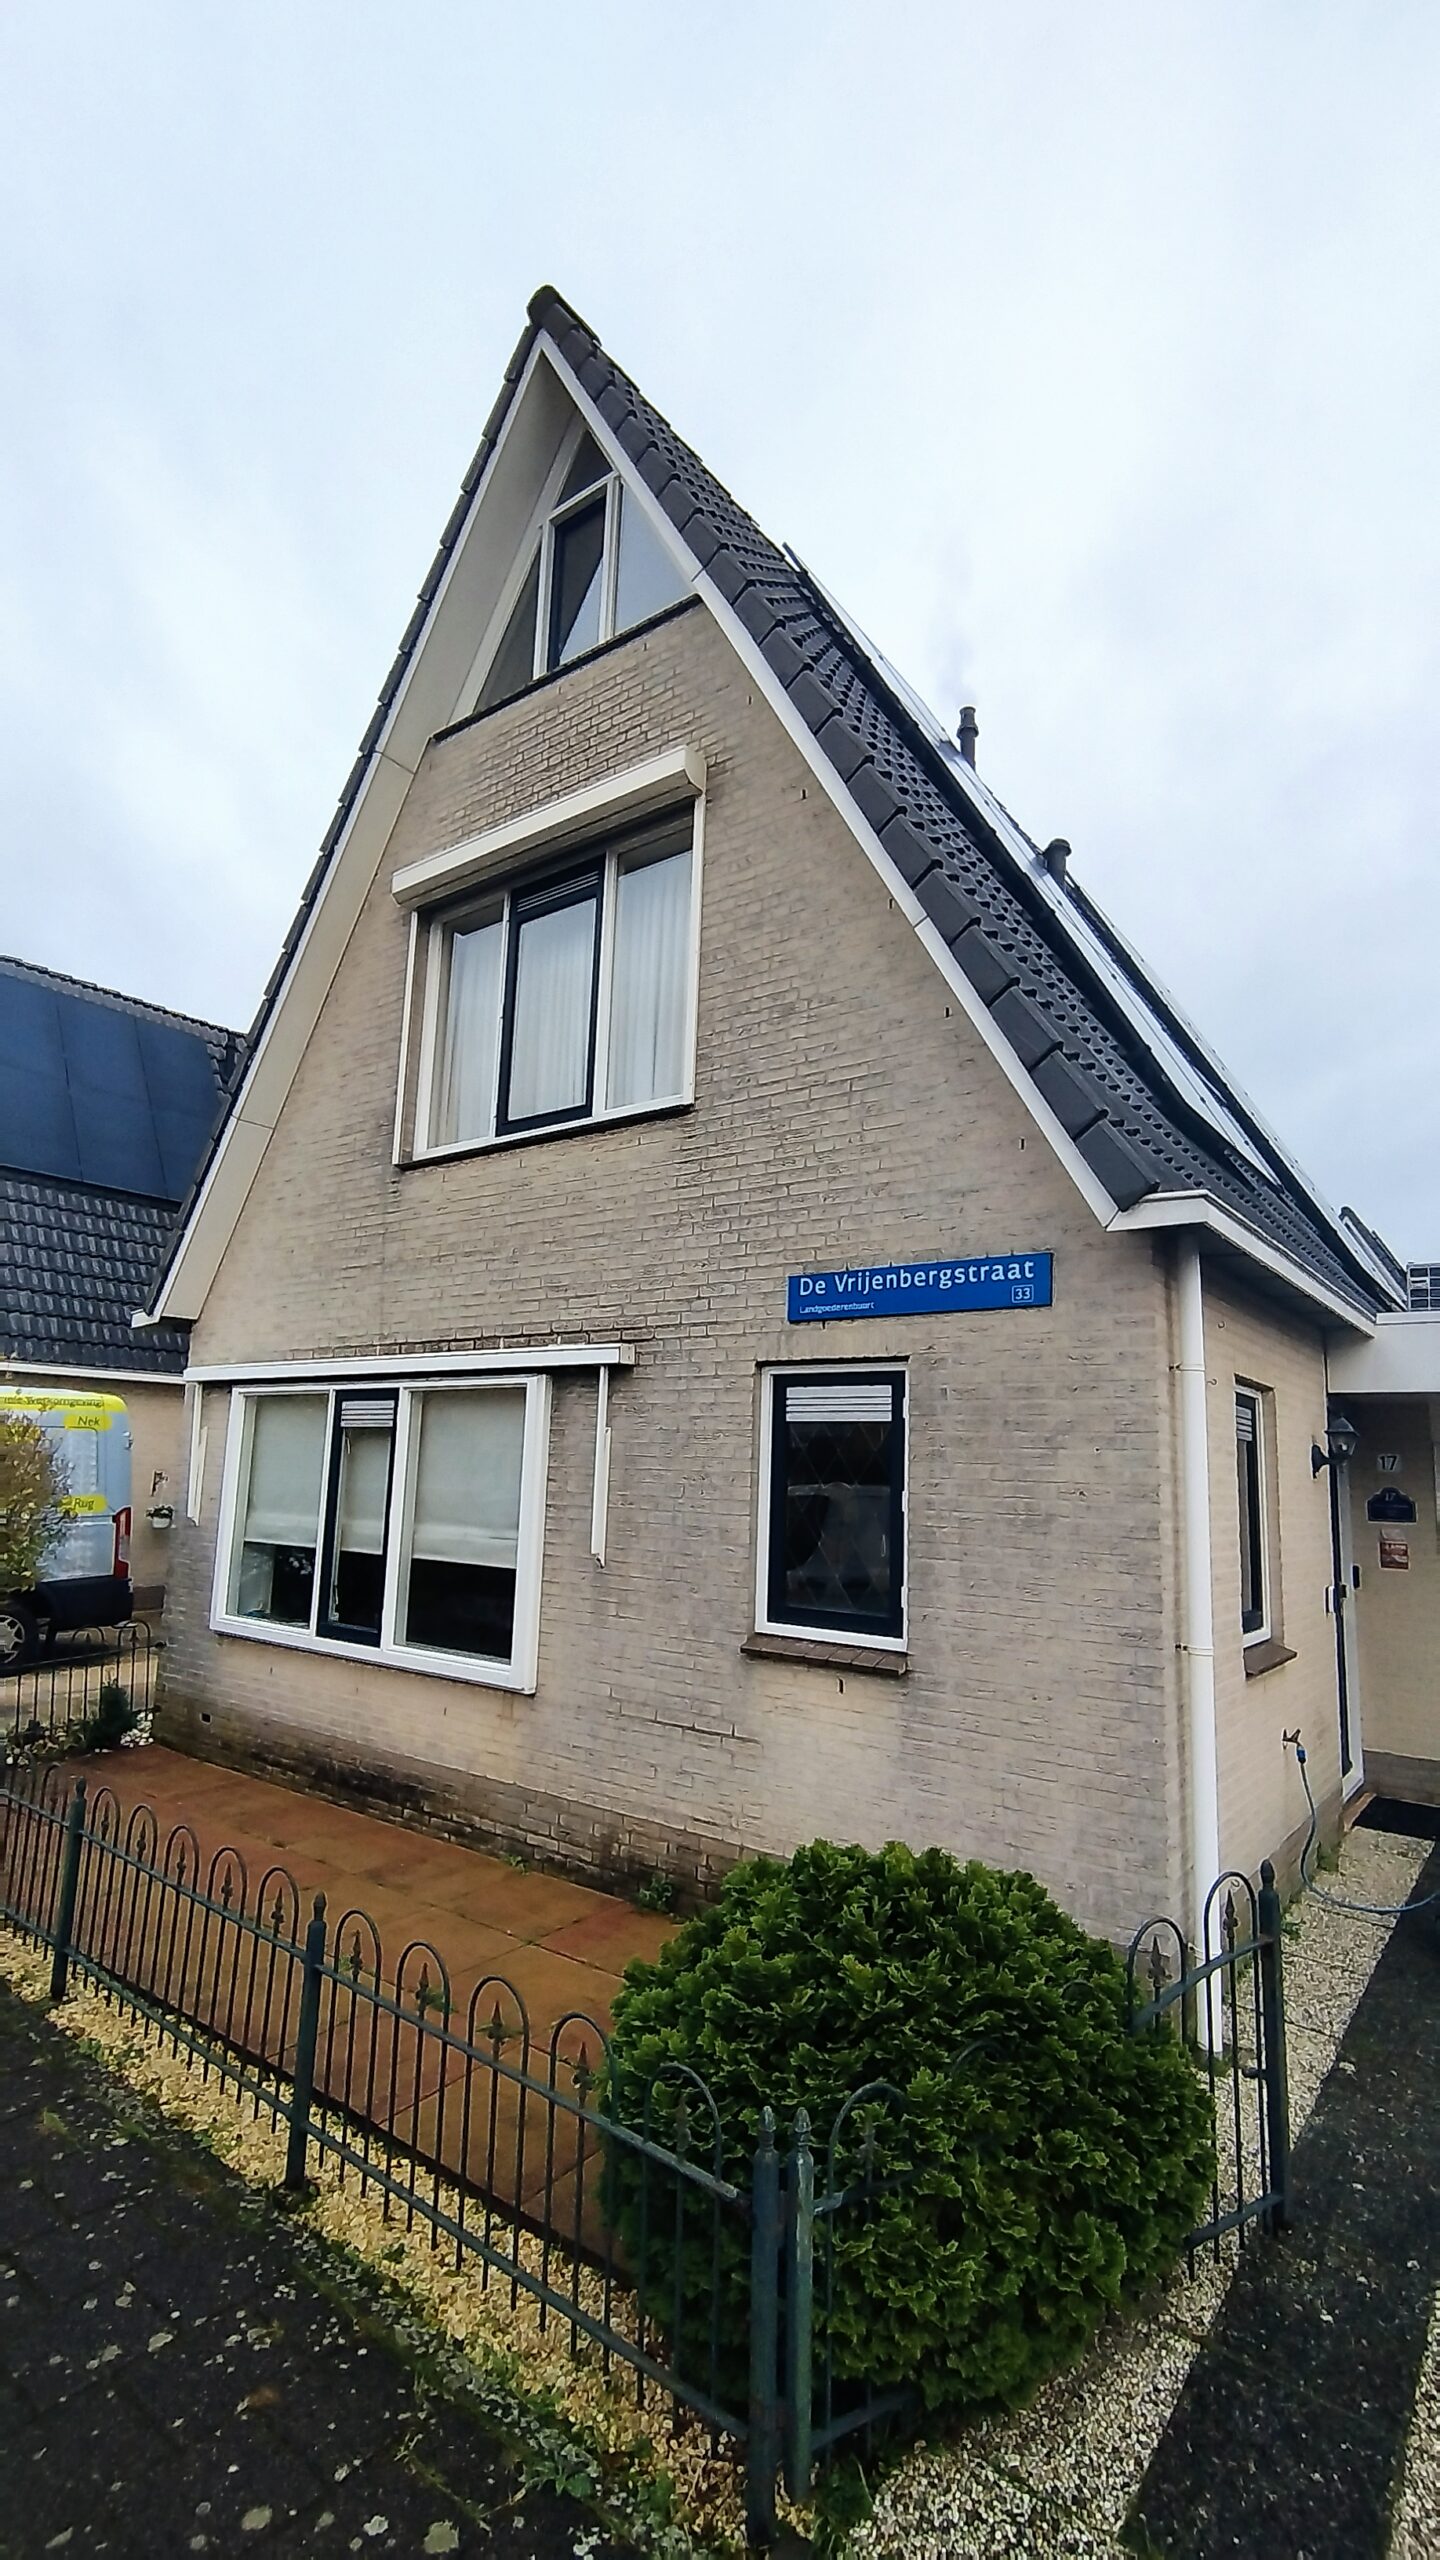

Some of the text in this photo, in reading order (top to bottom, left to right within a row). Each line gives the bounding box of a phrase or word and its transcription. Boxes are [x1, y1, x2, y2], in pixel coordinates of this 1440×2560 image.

[799, 1260, 1034, 1296] De Vrijenbergstraat
[1014, 1287, 1031, 1300] 33
[78, 1416, 100, 1426] Nek
[1379, 1455, 1398, 1471] 17
[75, 1498, 94, 1510] Rug
